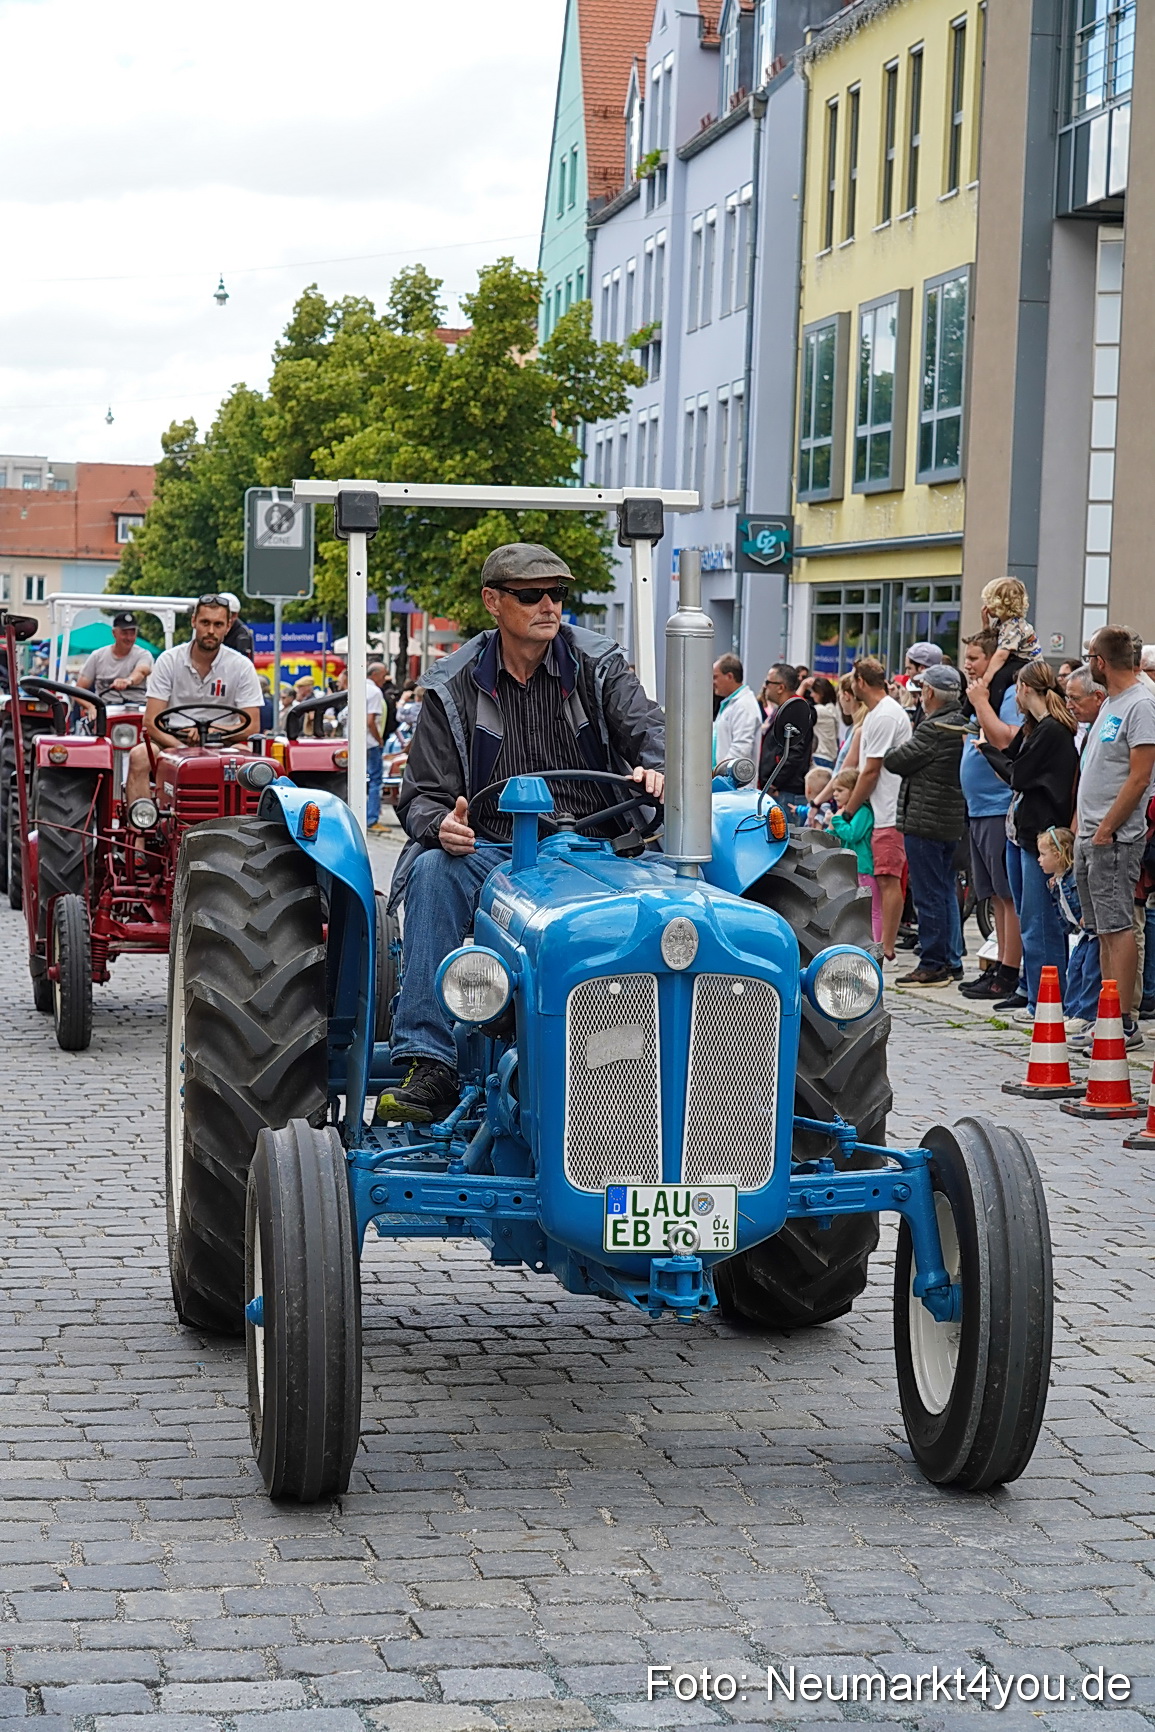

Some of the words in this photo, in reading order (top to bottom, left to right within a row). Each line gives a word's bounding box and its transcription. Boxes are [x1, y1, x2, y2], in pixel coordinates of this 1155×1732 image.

[756, 530, 777, 555] G2
[613, 1203, 621, 1213] D
[631, 1189, 691, 1217] LAU
[612, 1219, 651, 1247] EB
[713, 1218, 730, 1231] 04
[713, 1236, 730, 1248] 10
